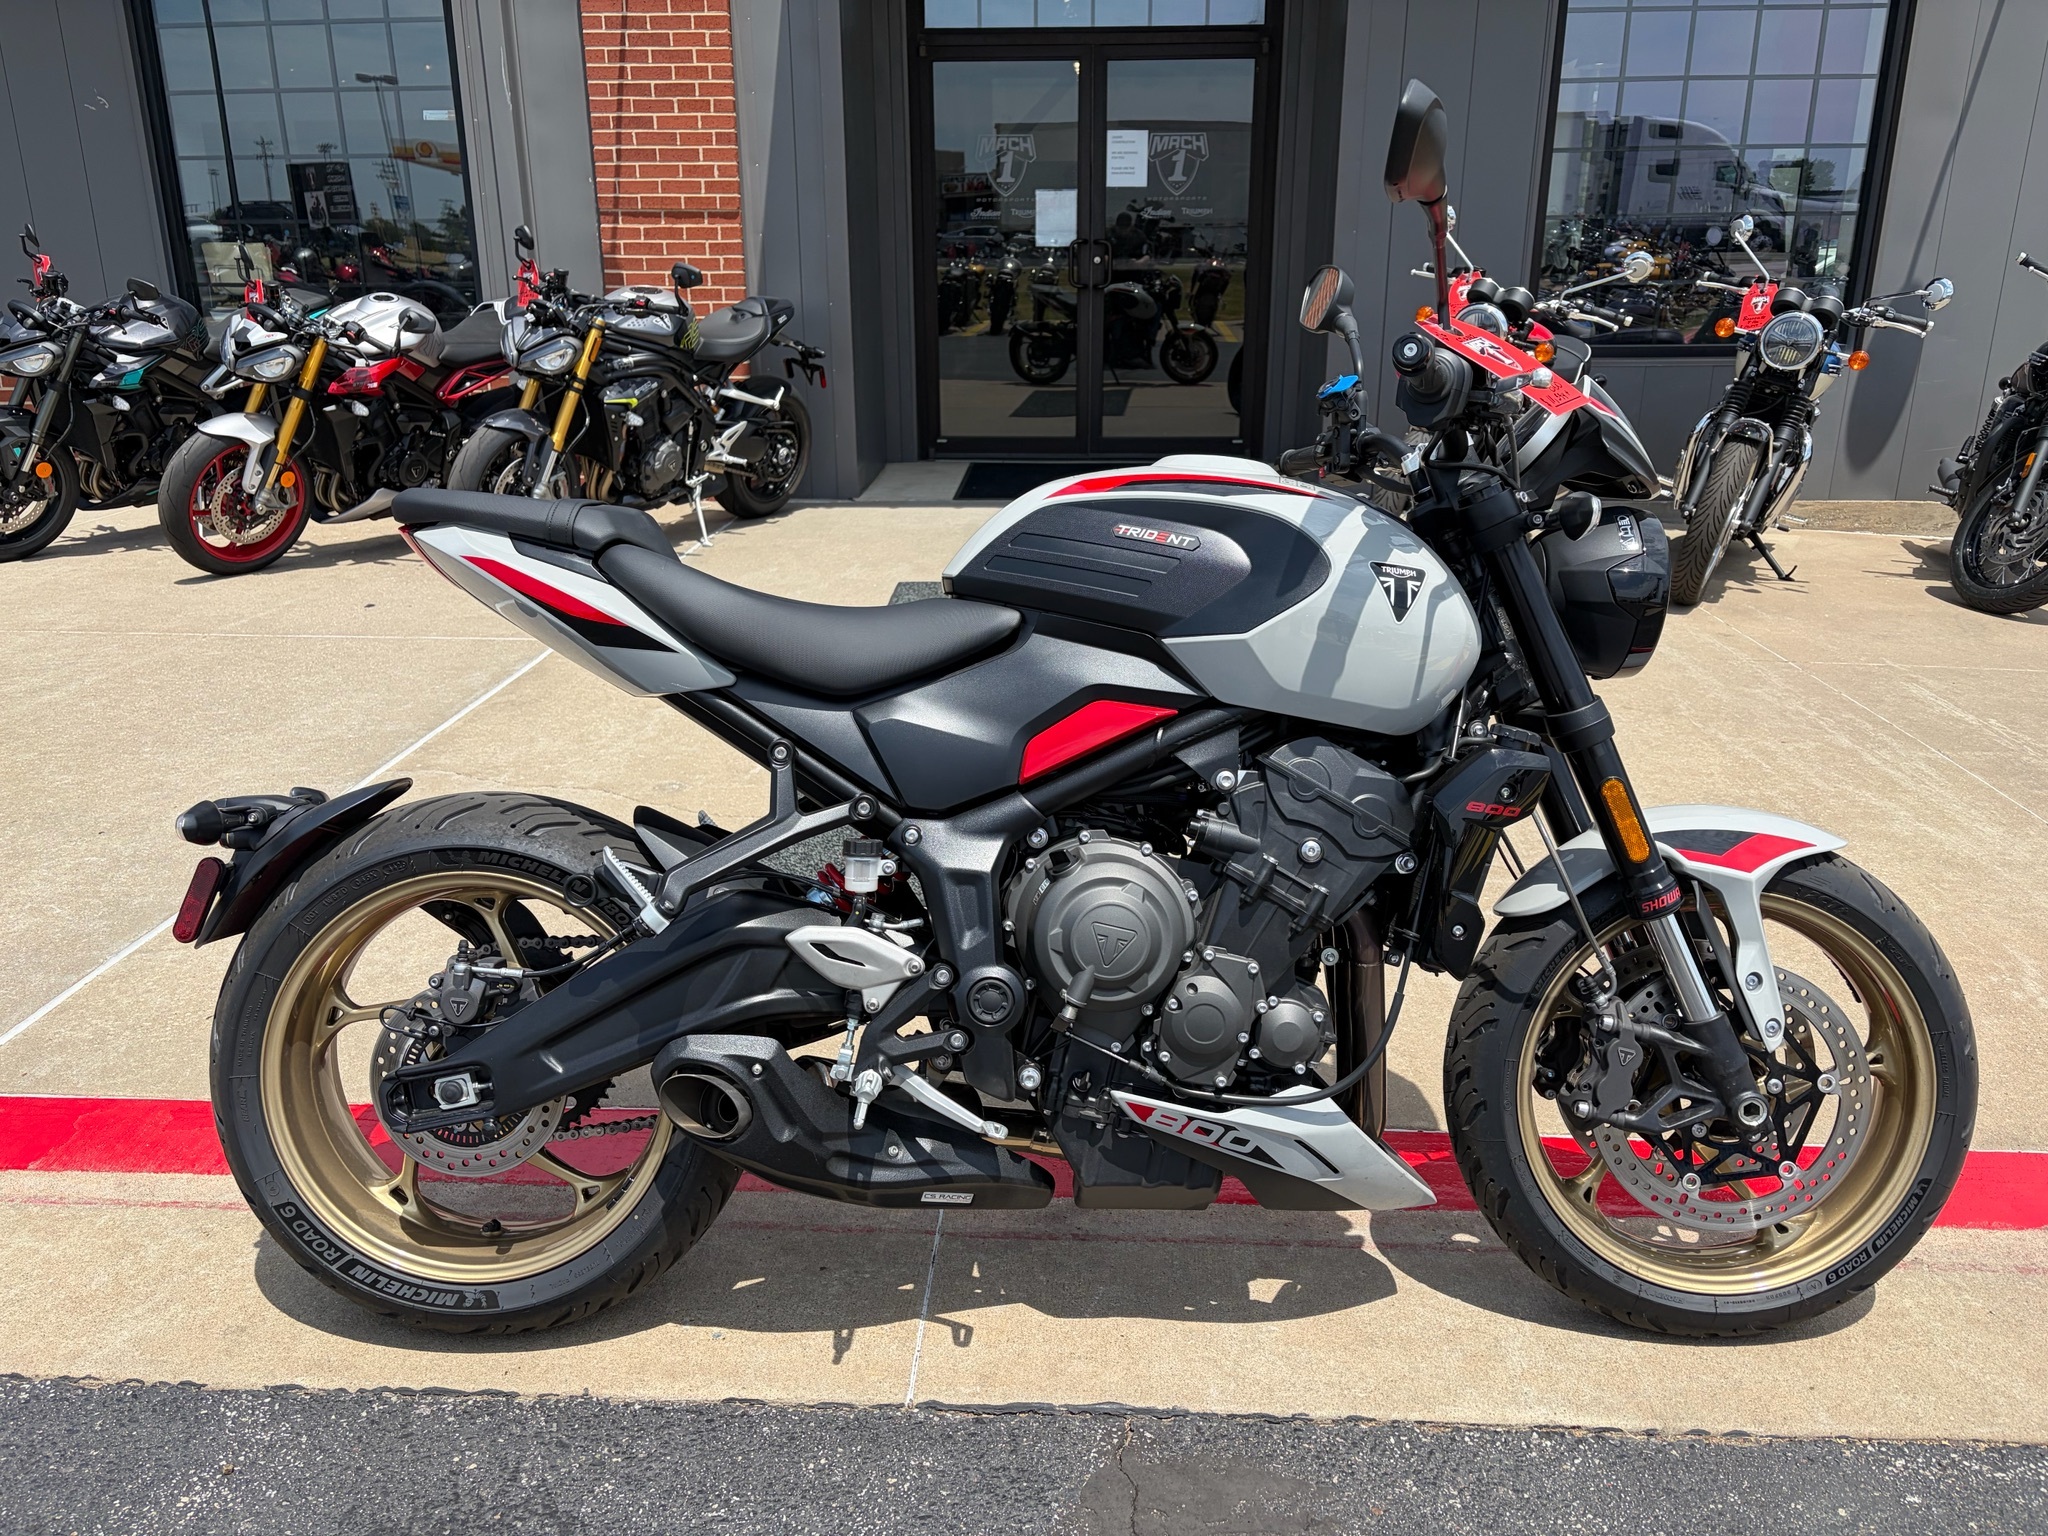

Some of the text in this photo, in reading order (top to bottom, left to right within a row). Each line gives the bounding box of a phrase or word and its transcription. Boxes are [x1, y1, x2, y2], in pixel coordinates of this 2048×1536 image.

[979, 137, 1033, 157] MACH
[1150, 135, 1205, 156] MACH
[996, 150, 1016, 183] 1
[1167, 149, 1187, 181] 1
[970, 207, 1002, 217] Indian
[1140, 206, 1173, 218] Indian
[1116, 524, 1196, 547] TRIDENT
[1380, 565, 1417, 578] TRIUMPH
[1465, 801, 1522, 818] 800
[1641, 887, 1681, 913] SHOWA
[1534, 940, 1576, 990] MICHELIN
[1146, 1108, 1252, 1153] 800
[279, 1205, 342, 1264] ROAD 6
[1874, 1195, 1919, 1247] MICHELIN
[1828, 1251, 1868, 1283] ROAD 6
[350, 1265, 459, 1307] MICHELIN
